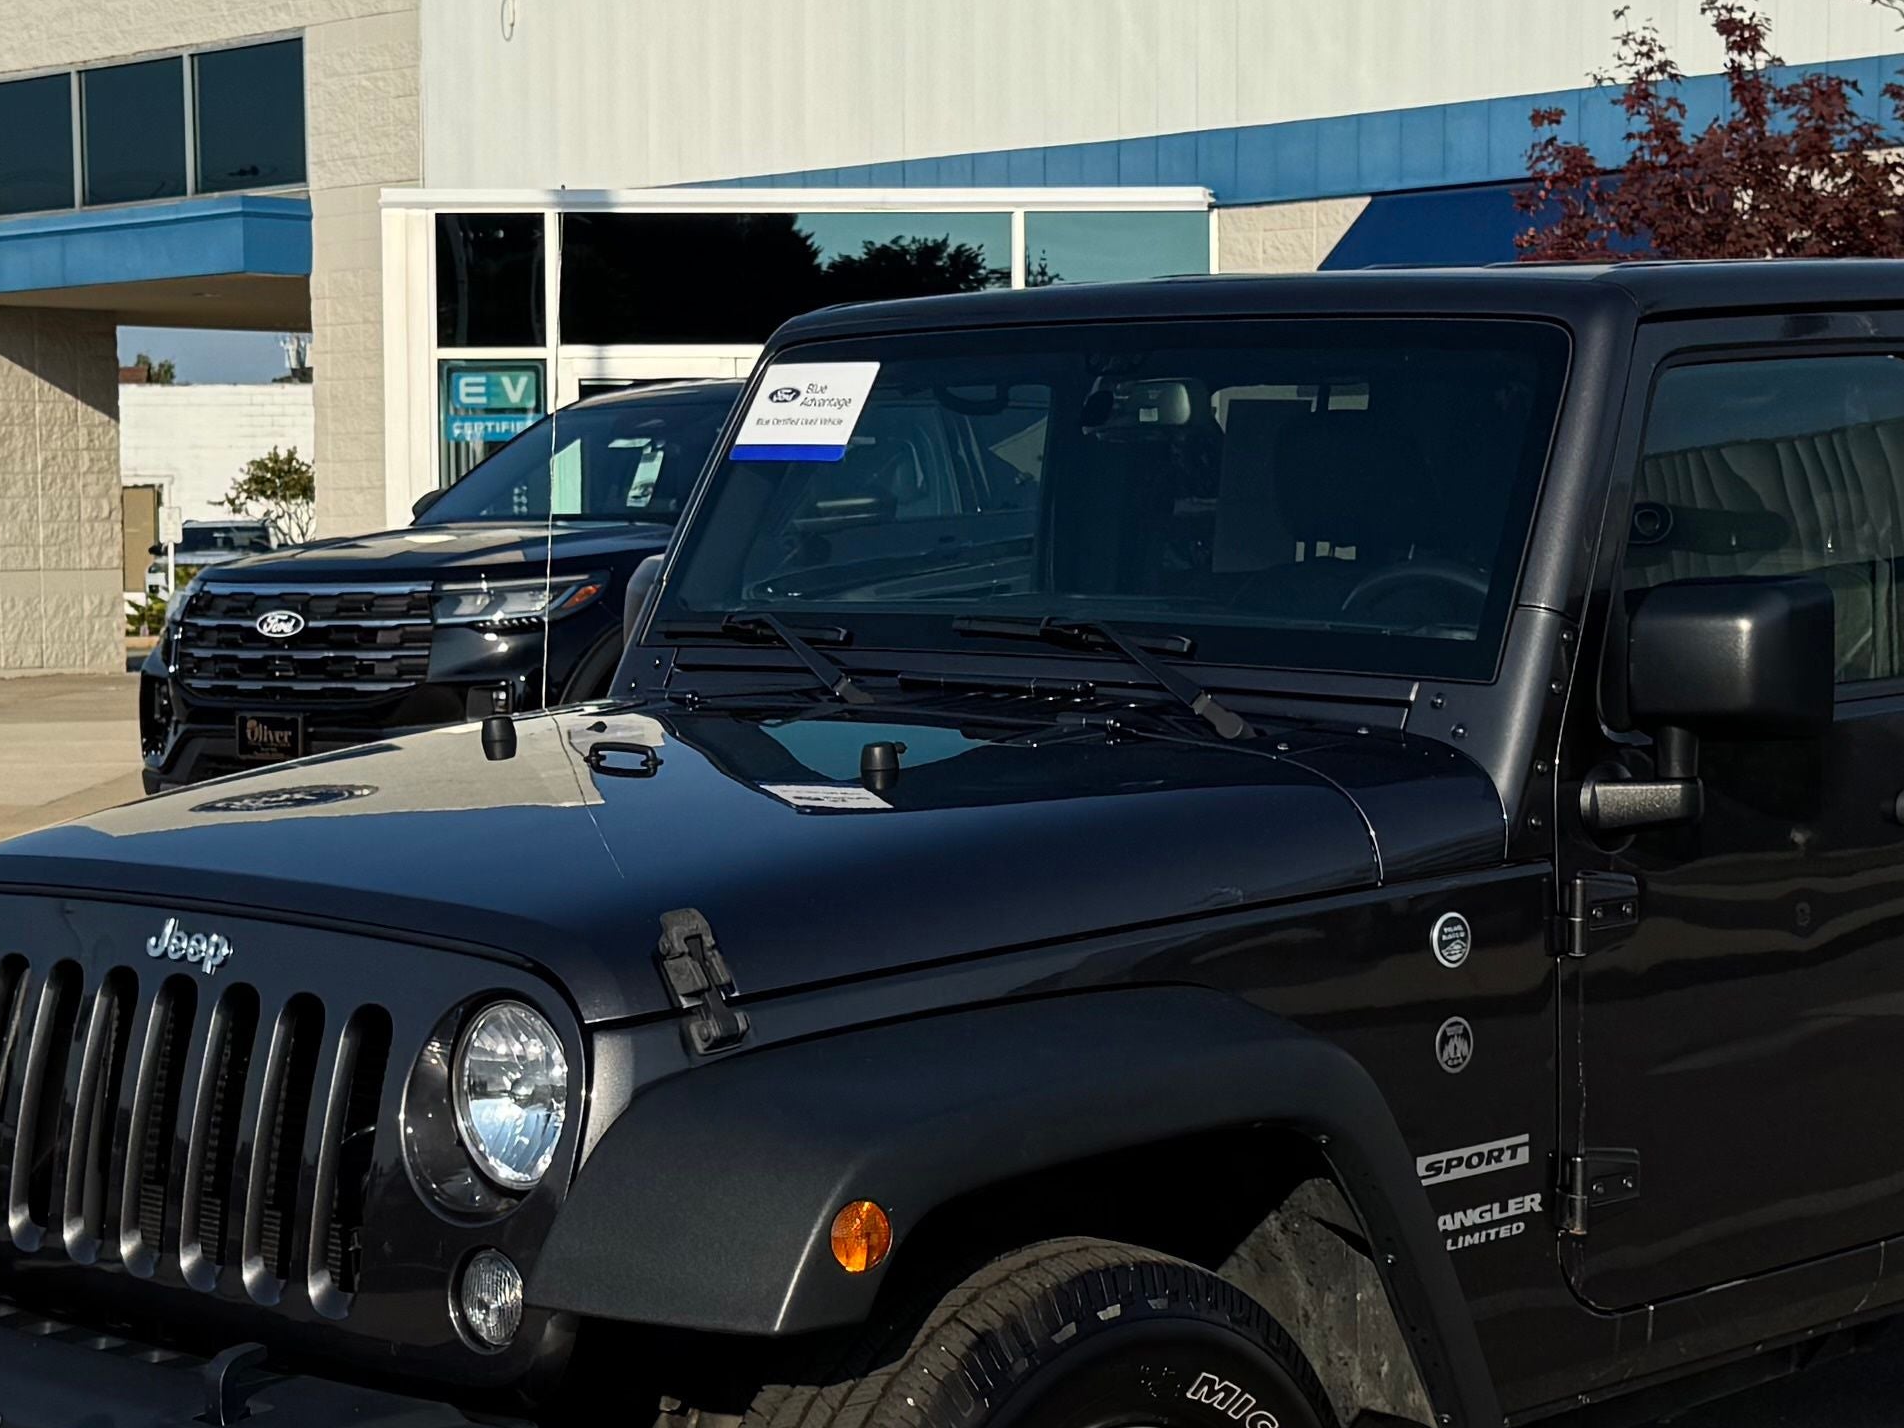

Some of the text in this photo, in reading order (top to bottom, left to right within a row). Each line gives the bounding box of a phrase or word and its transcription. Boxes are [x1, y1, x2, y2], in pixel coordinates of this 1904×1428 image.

[805, 383, 829, 394] Blue
[799, 396, 852, 410] Advantage
[262, 614, 296, 633] Ford
[146, 917, 230, 975] Jeep
[1422, 1140, 1529, 1180] SPORT
